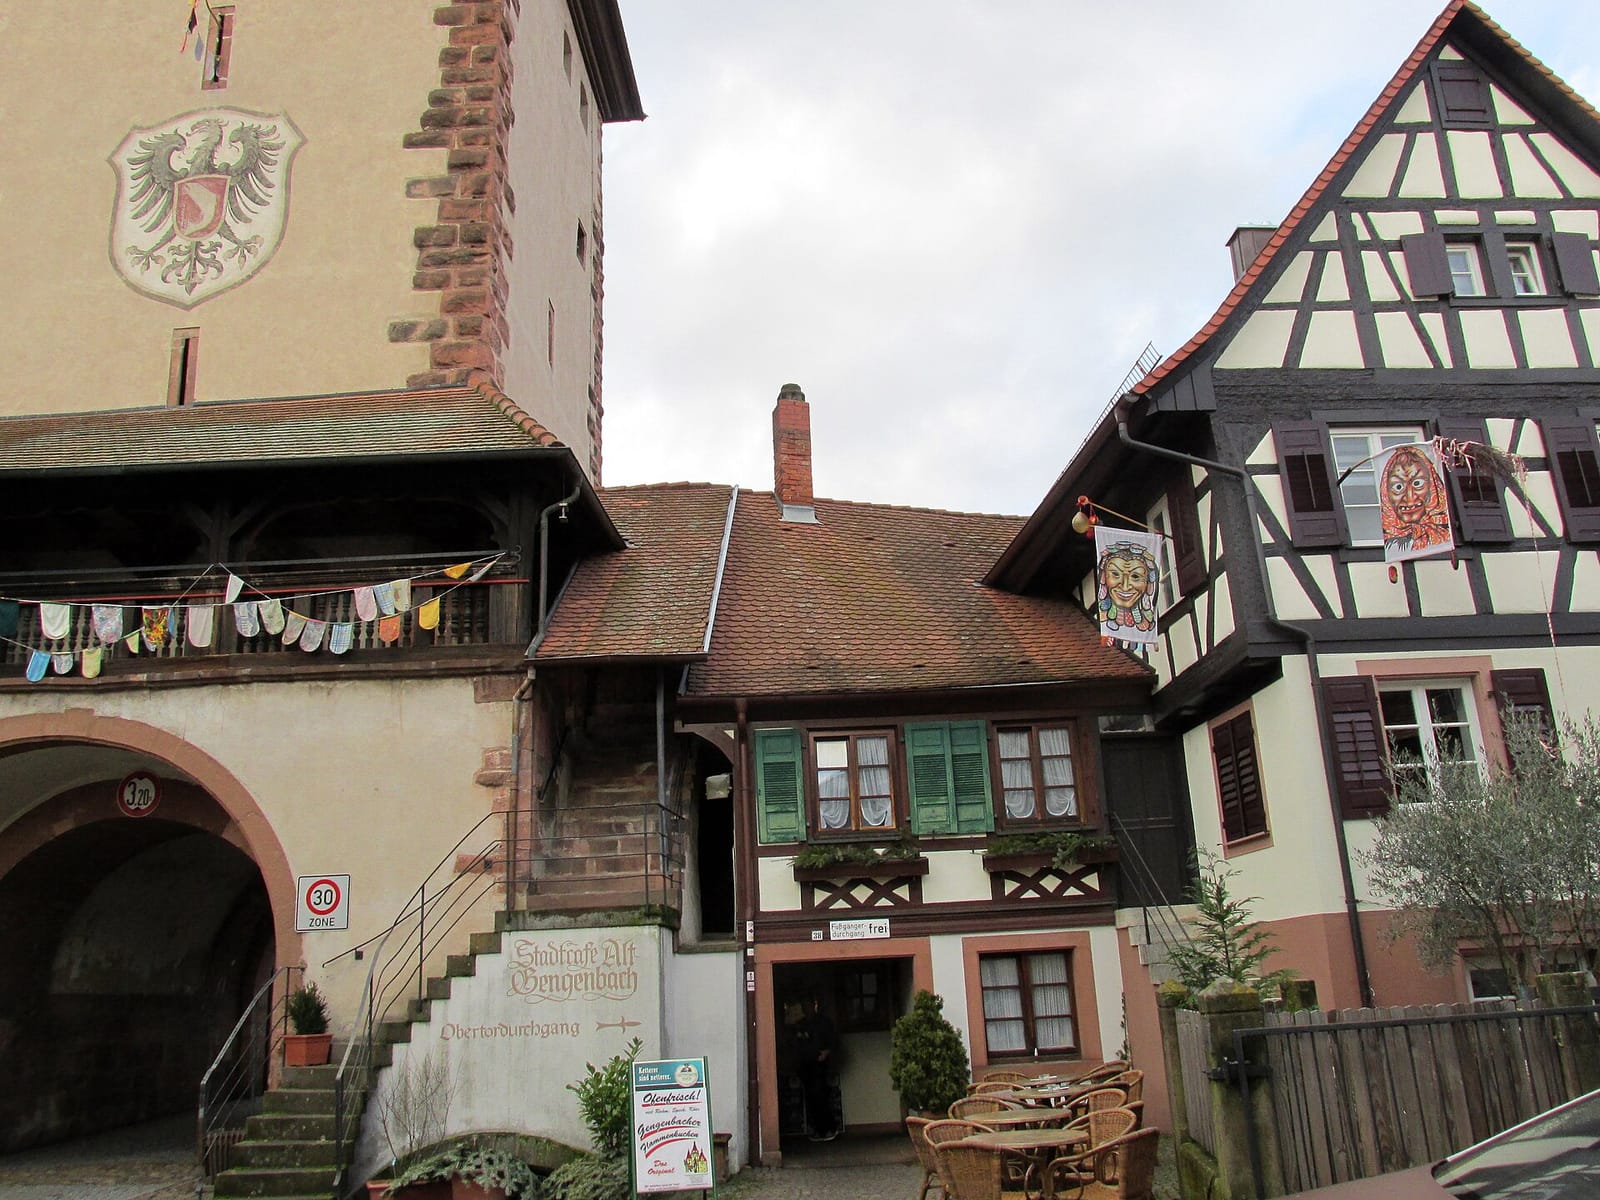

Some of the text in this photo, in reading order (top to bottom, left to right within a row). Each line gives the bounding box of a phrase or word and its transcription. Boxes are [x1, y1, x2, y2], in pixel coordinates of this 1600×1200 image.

[313, 889, 333, 906] 30
[309, 917, 336, 927] ZONE
[868, 923, 888, 934] frei
[832, 930, 865, 938] durchgang
[602, 938, 638, 968] Alt
[507, 967, 638, 1003] Gengenbach
[440, 1020, 580, 1041] Obertordurchgang
[643, 1089, 701, 1105] Ofenfrisch!
[637, 1116, 701, 1140] Gengenbacher
[640, 1129, 699, 1154] Flammenkuchen
[653, 1159, 668, 1167] Das
[647, 1167, 675, 1176] Original
